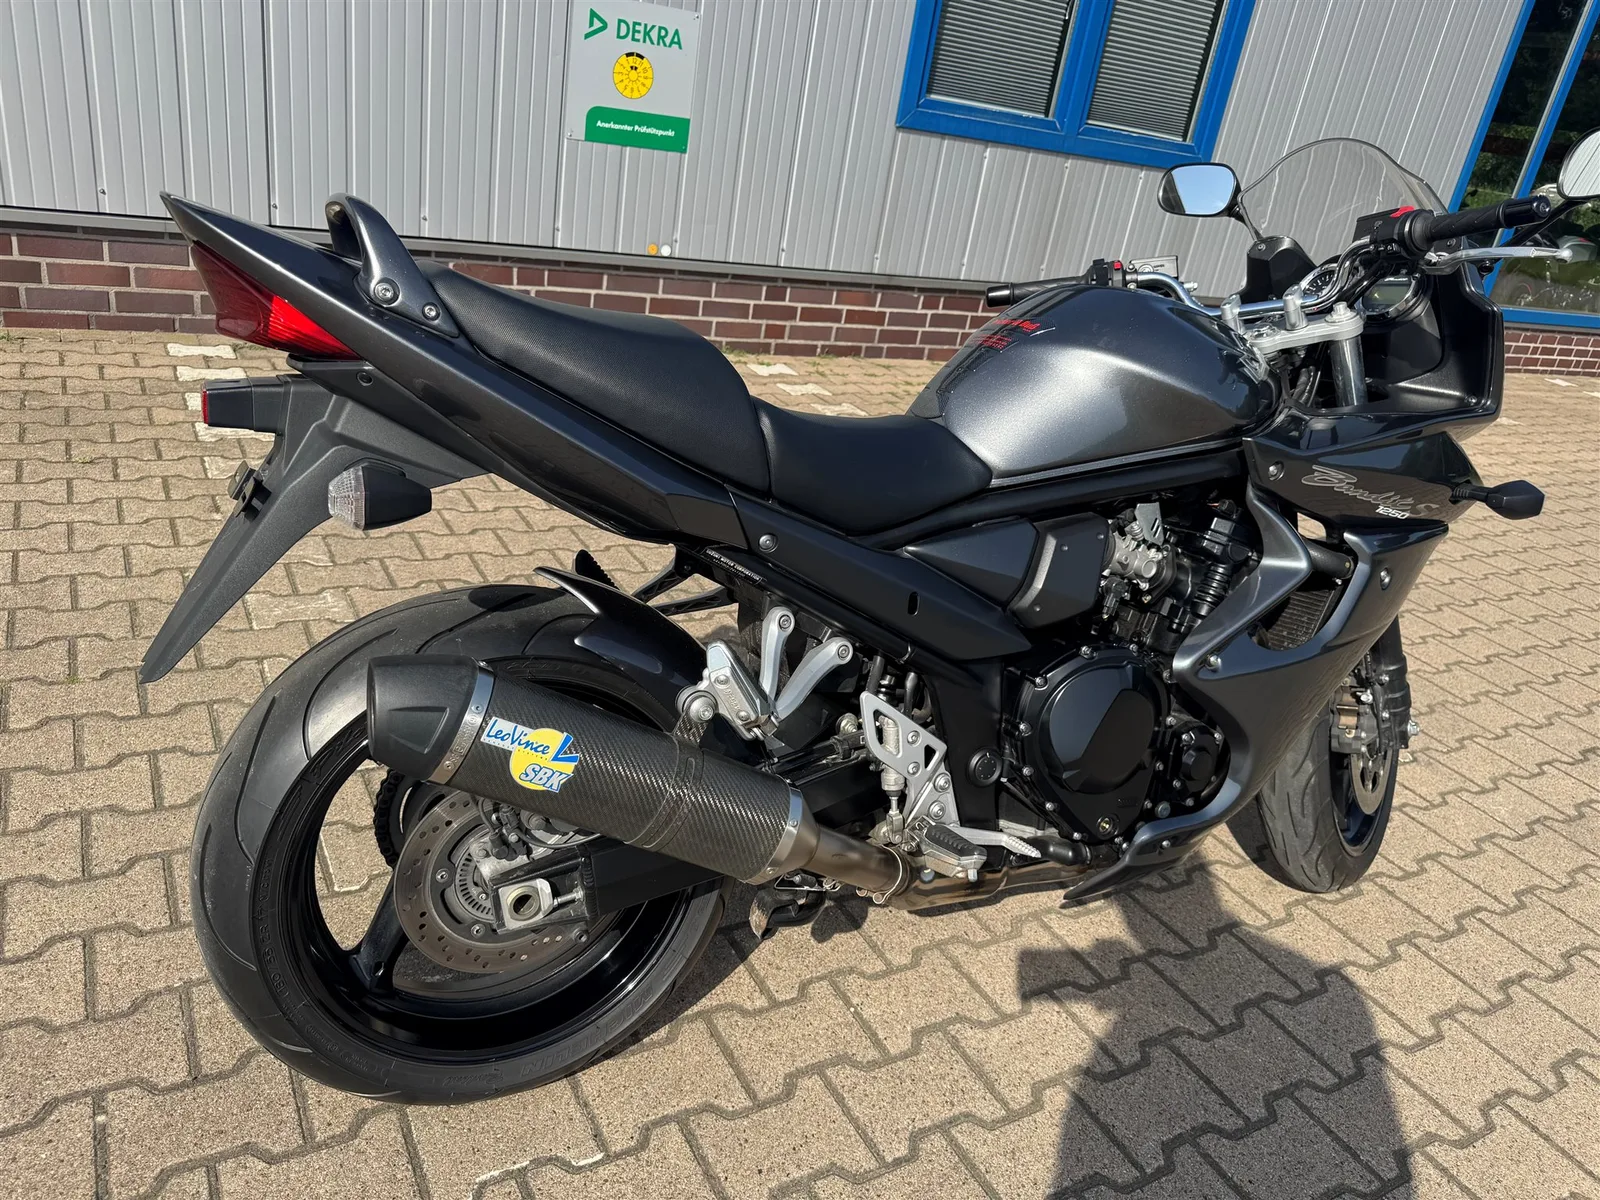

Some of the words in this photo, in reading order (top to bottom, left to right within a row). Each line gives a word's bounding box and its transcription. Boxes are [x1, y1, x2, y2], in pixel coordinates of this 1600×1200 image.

[616, 18, 683, 50] DEKRA
[596, 120, 633, 131] Anerkannter
[634, 125, 675, 137] Prüfstützpunkt
[1301, 464, 1415, 510] Bandit
[1375, 505, 1410, 519] 1250
[486, 719, 551, 755] LeoVince
[519, 763, 570, 793] SBK
